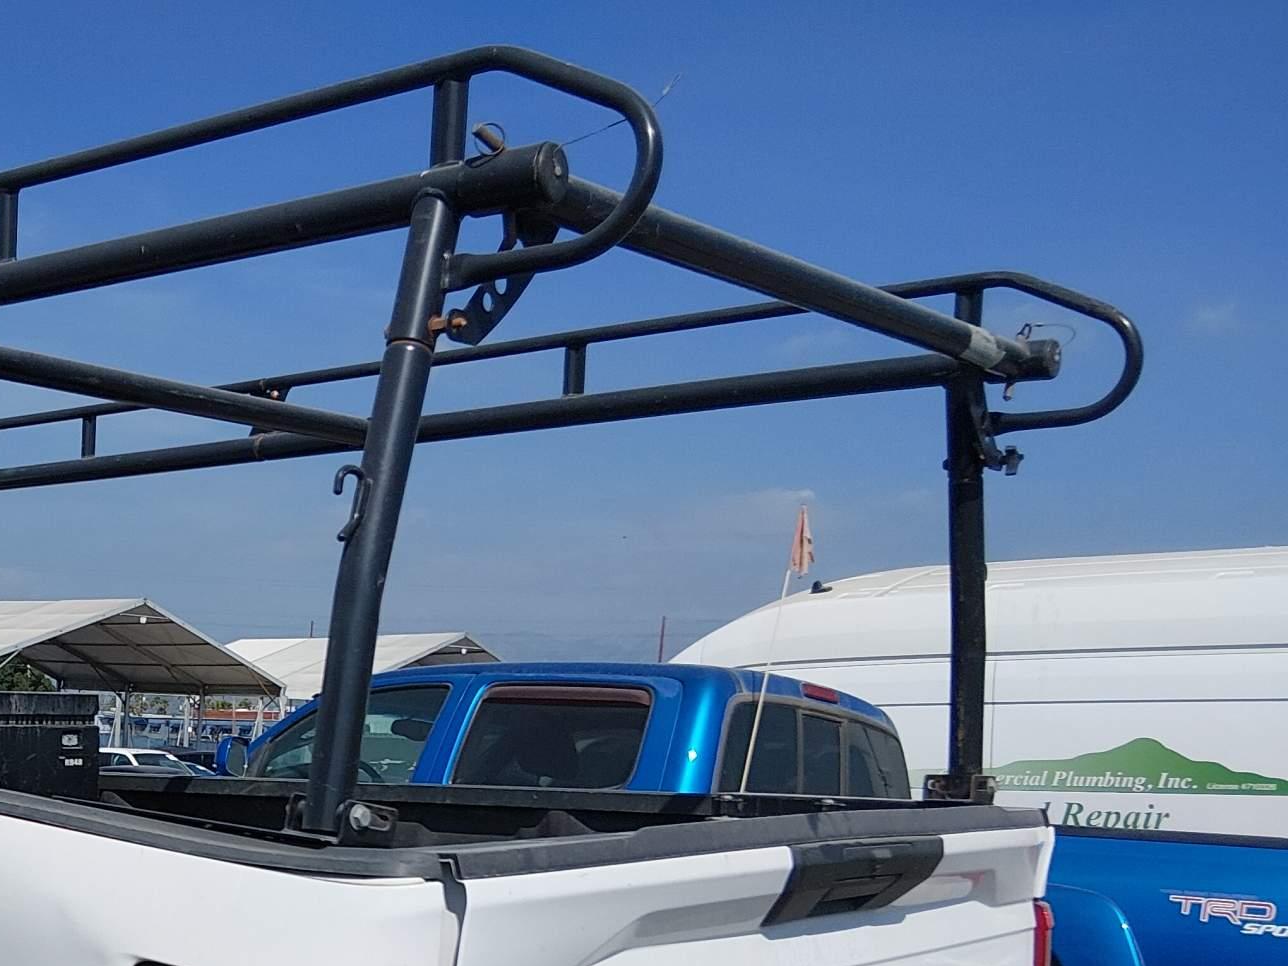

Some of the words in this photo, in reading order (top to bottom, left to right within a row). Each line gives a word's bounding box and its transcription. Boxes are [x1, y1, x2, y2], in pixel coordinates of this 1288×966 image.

[996, 770, 1048, 786] ercial
[1051, 770, 1153, 792] Plumbing,
[1157, 772, 1198, 789] Inc.
[1061, 801, 1170, 829] Repair
[1169, 894, 1277, 925] TRD
